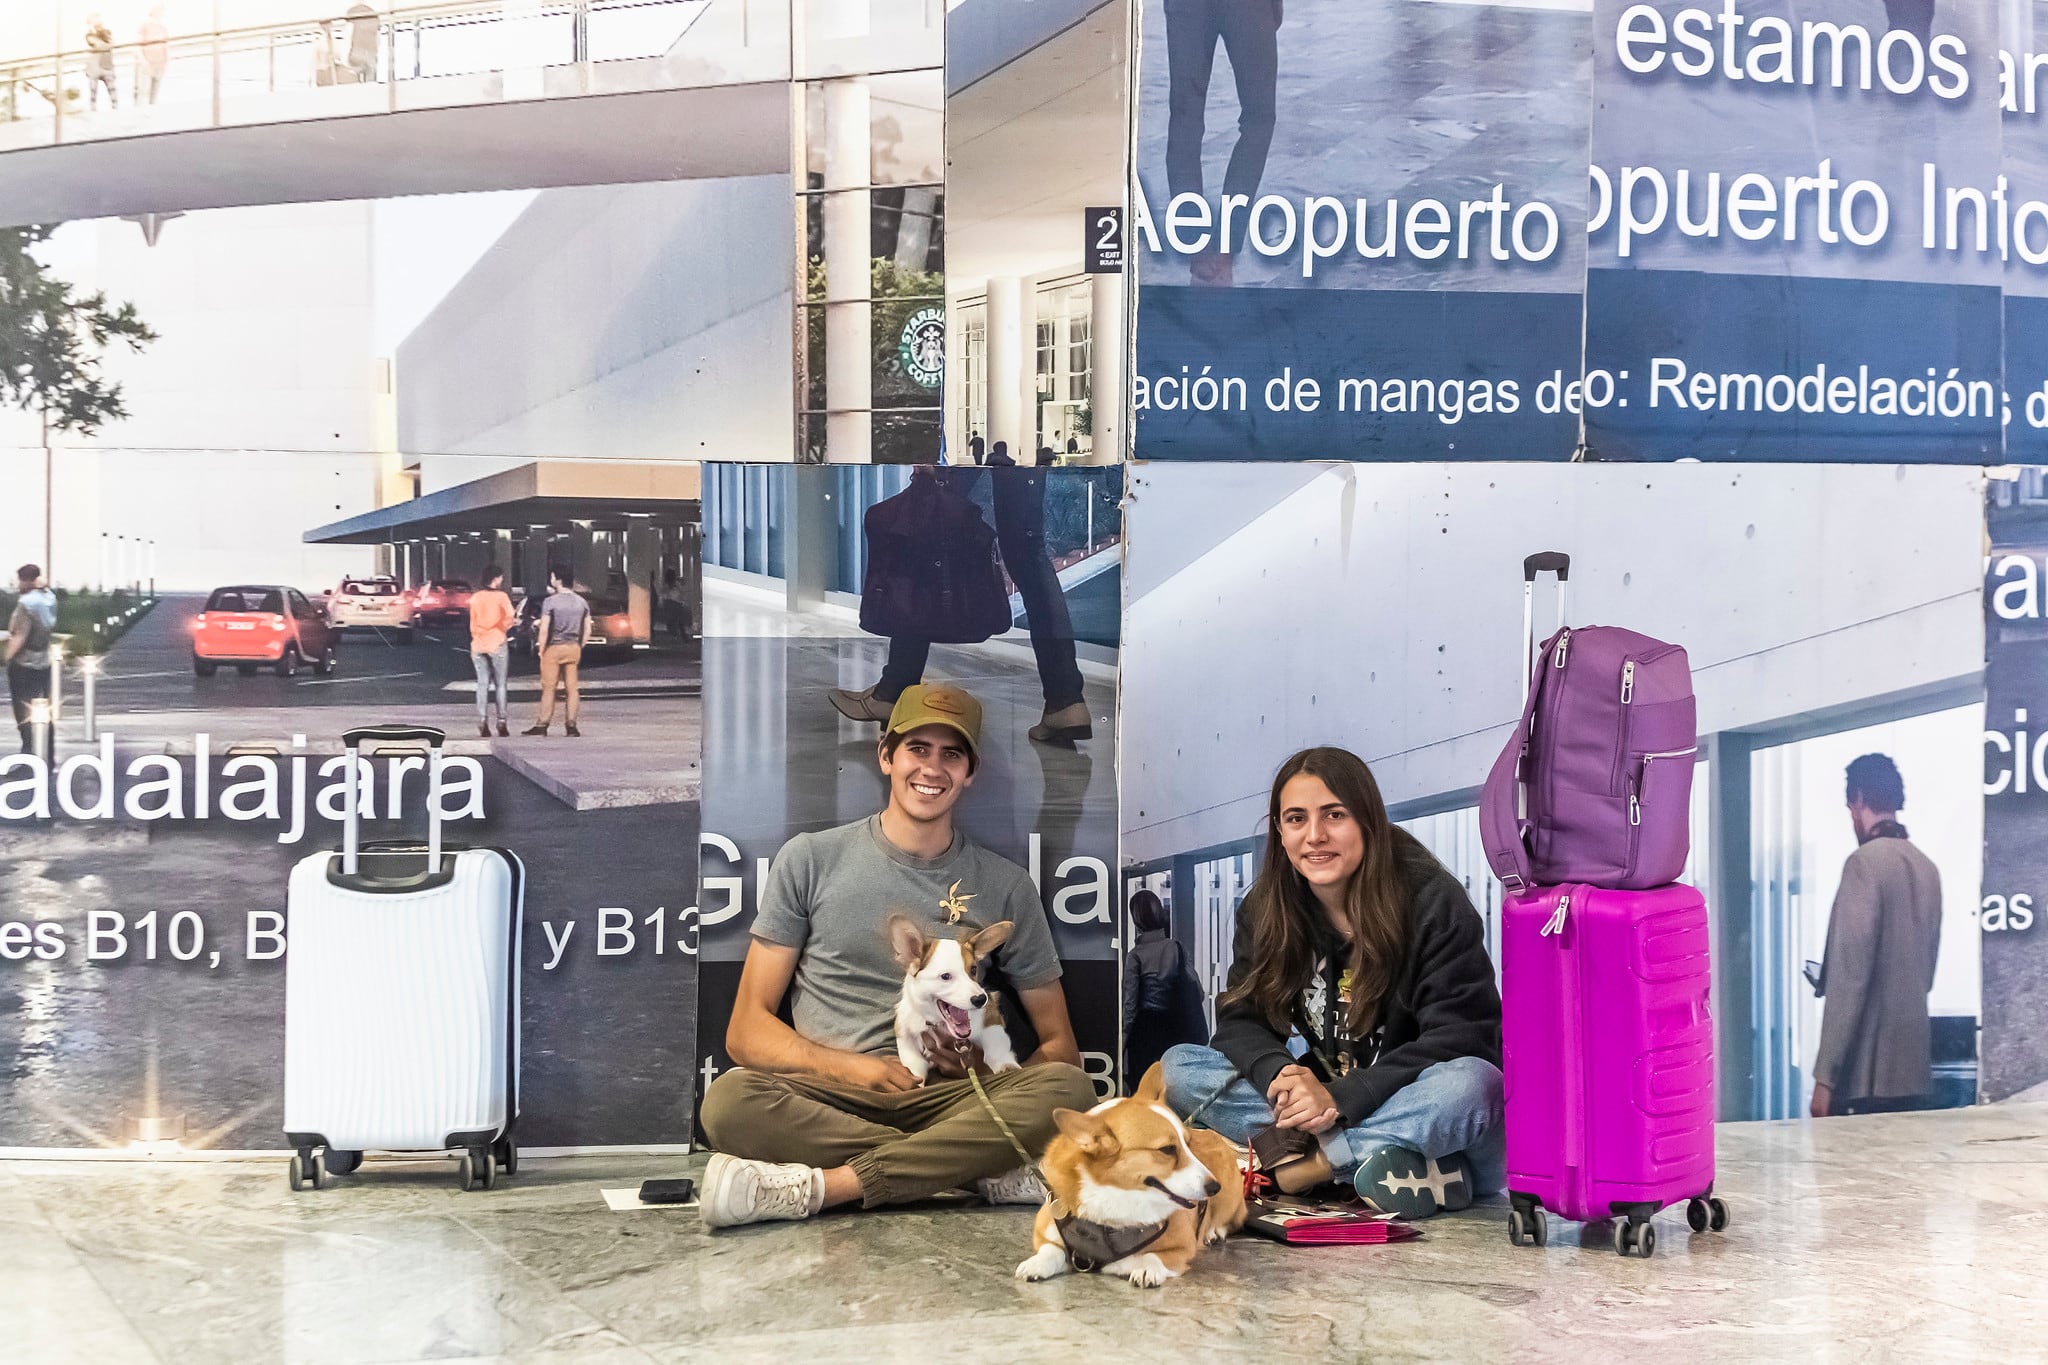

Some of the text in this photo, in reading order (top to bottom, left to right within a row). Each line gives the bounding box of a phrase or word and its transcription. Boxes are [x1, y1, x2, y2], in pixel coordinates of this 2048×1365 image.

[1616, 0, 1969, 99] estamos
[1096, 216, 1118, 249] 2
[1134, 366, 1583, 425] ación de mangas de
[1649, 358, 1994, 418] Remodelación
[0, 733, 486, 843] adalajara
[0, 920, 66, 960] es
[87, 909, 222, 969] B10,
[542, 921, 576, 970] y
[597, 906, 699, 956] B13
[1981, 893, 2034, 932] as
